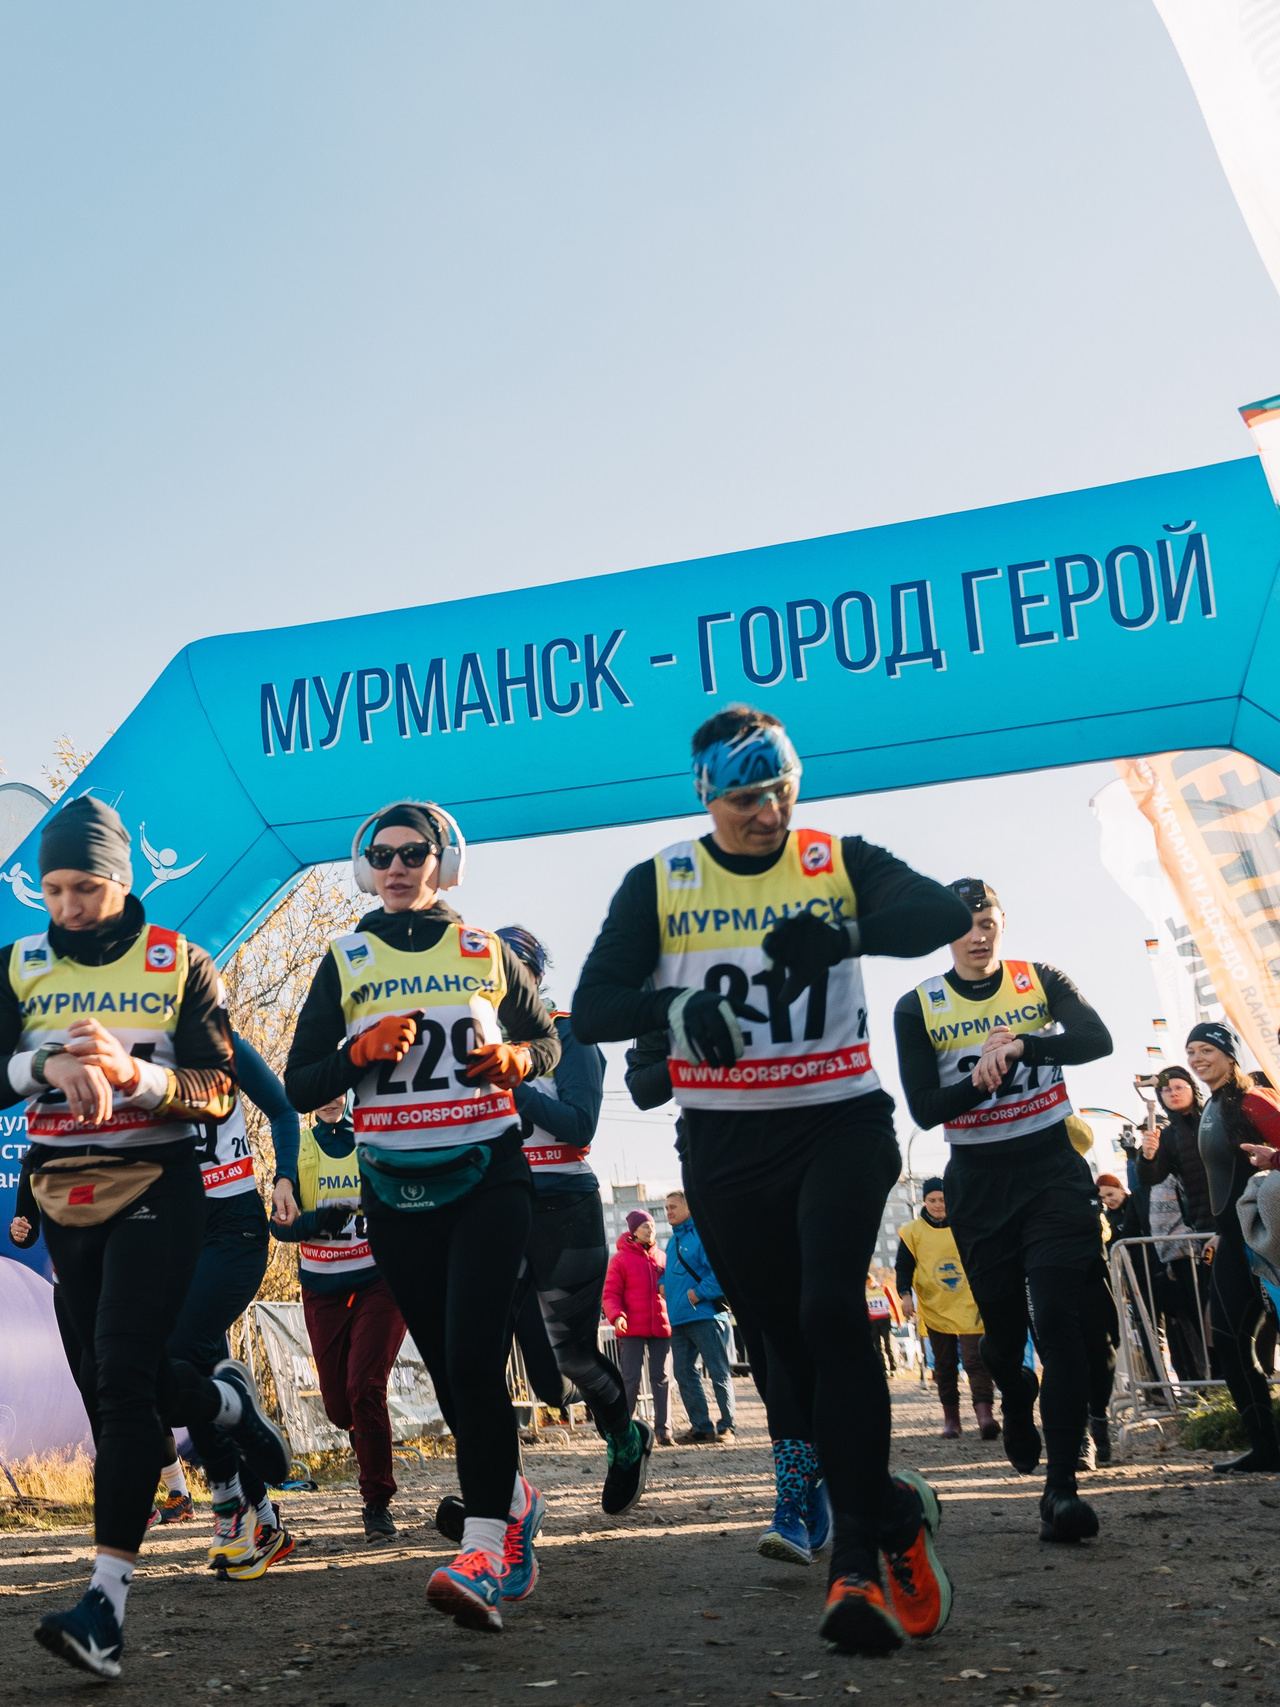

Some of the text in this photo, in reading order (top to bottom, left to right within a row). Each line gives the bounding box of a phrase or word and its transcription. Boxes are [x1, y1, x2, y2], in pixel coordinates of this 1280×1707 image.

[260, 628, 633, 757] МУРМАНСК
[697, 578, 946, 694] ГОРОД
[961, 519, 1216, 654] ГЕРОЙ
[18, 991, 177, 1018] МУРМАНСК
[351, 974, 494, 1005] МУРМАНСК
[930, 1002, 1048, 1044] МУРМАНСК
[678, 1053, 867, 1084] WWW.GORSPORT51.RU
[362, 1096, 511, 1127] WWW.GORSPORT51.RU
[231, 1135, 251, 1159] 21
